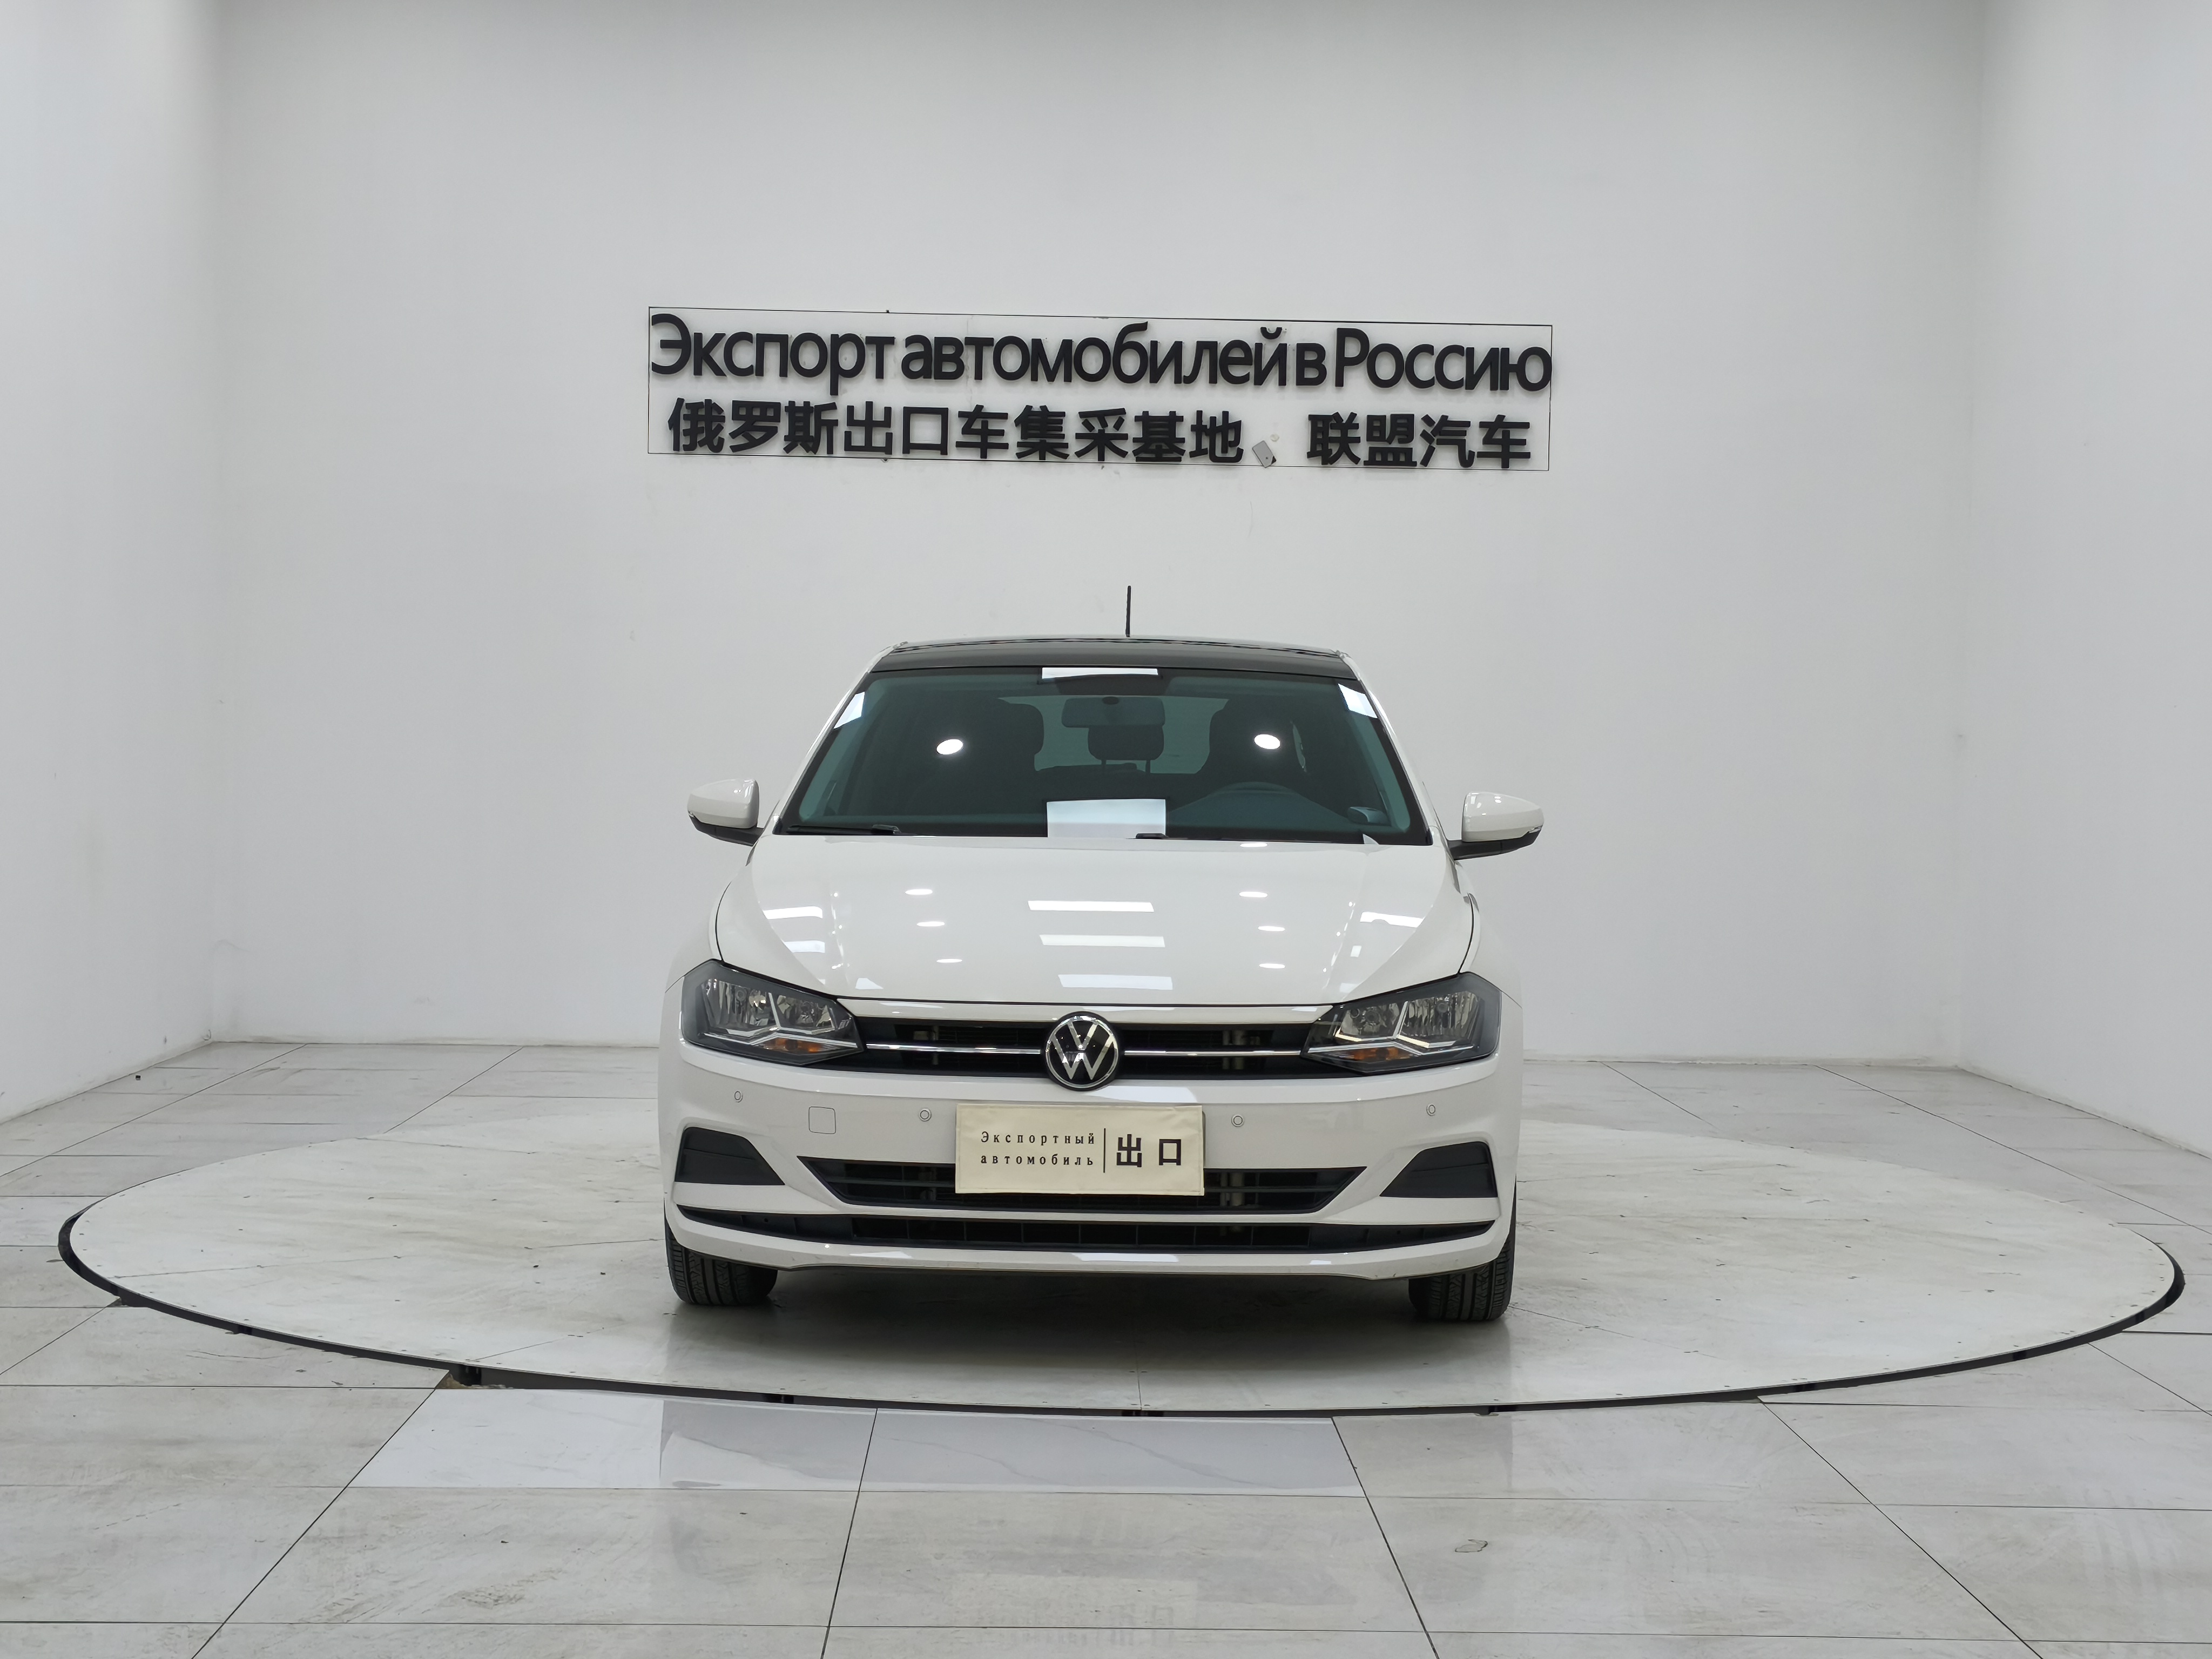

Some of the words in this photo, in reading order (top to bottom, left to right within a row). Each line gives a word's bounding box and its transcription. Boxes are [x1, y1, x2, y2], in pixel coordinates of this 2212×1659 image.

[651, 312, 895, 396] Экспорт
[900, 320, 1288, 387] автомобилей
[1296, 342, 1327, 387] в
[1335, 327, 1552, 392] Россию
[667, 397, 1244, 463] 俄罗斯出口车集采基地
[1306, 411, 1532, 469] 联盟汽车
[981, 1131, 1095, 1146] Экспортный
[1116, 1134, 1182, 1168] 出口
[981, 1154, 1094, 1166] автомобиль
